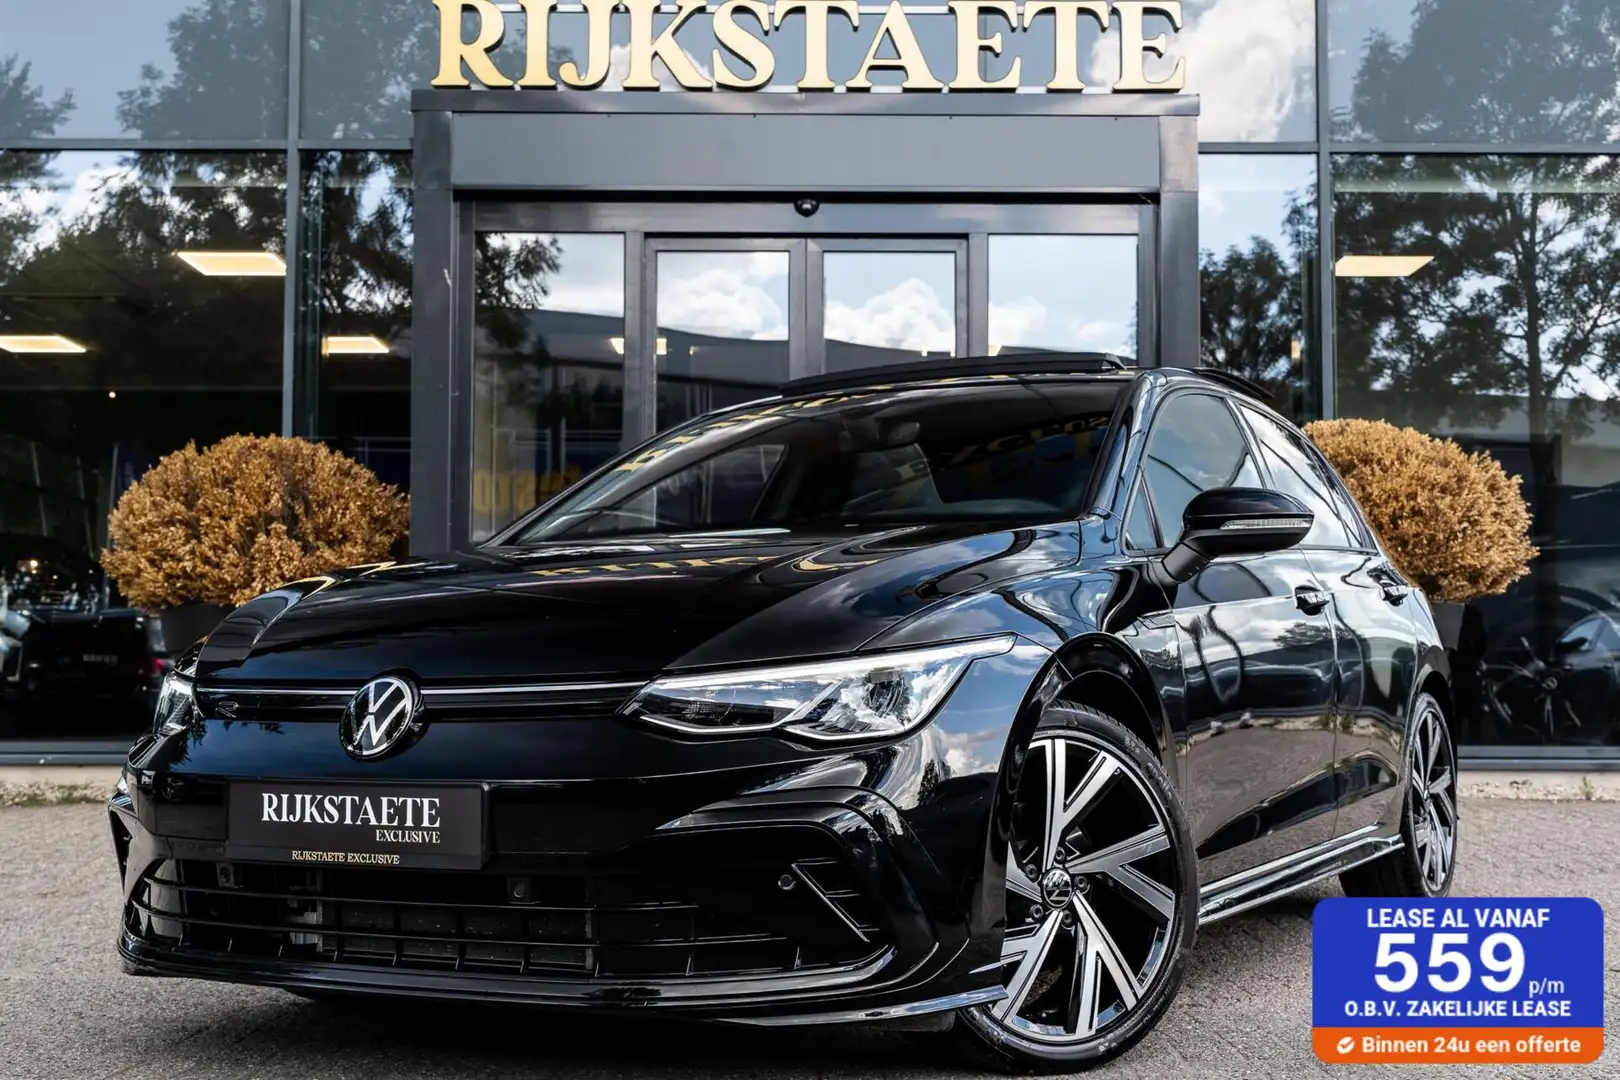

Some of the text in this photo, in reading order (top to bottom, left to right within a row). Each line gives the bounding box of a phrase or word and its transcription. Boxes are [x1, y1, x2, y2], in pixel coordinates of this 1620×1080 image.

[430, 0, 1186, 92] RIJKSTAETE
[262, 793, 441, 828] RIJKSTAETE
[376, 830, 441, 844] EXCLUSIVE
[292, 851, 400, 864] RIJKSTAETE EXCLUSIVE
